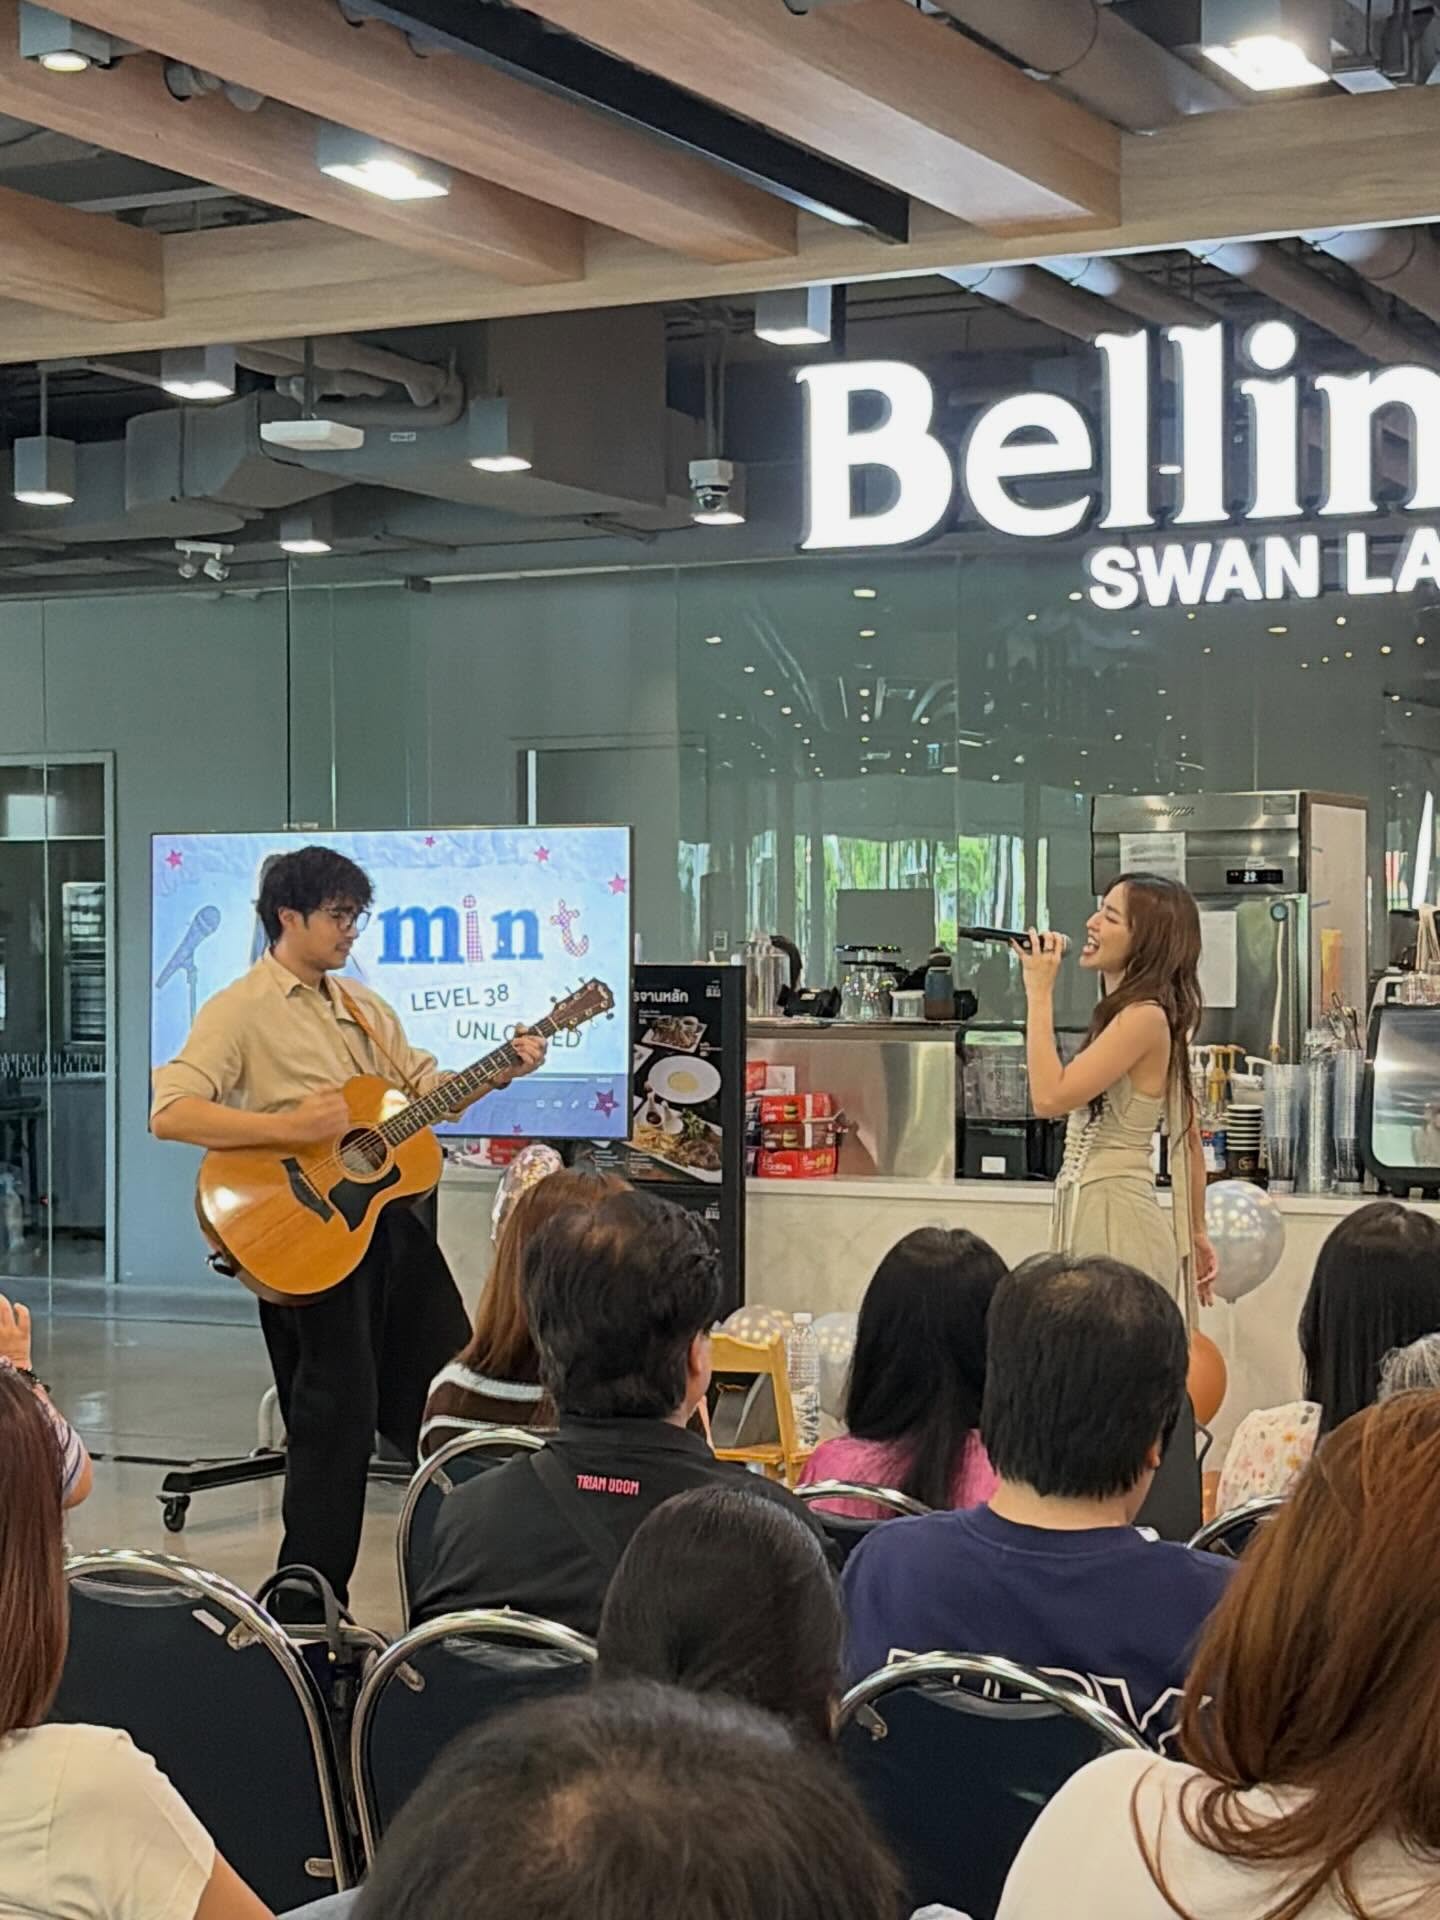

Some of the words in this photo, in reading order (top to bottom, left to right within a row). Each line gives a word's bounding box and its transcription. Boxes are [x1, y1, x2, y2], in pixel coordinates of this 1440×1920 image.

[796, 320, 1440, 550] Bellin
[1088, 535, 1320, 610] SWAN
[1346, 527, 1440, 596] LA
[377, 895, 589, 964] mint
[411, 987, 479, 1011] LEVEL
[484, 983, 509, 1007] 38
[457, 1020, 583, 1048] UNLOED
[576, 1474, 607, 1491] TRIAM
[608, 1478, 639, 1496] UDOM
